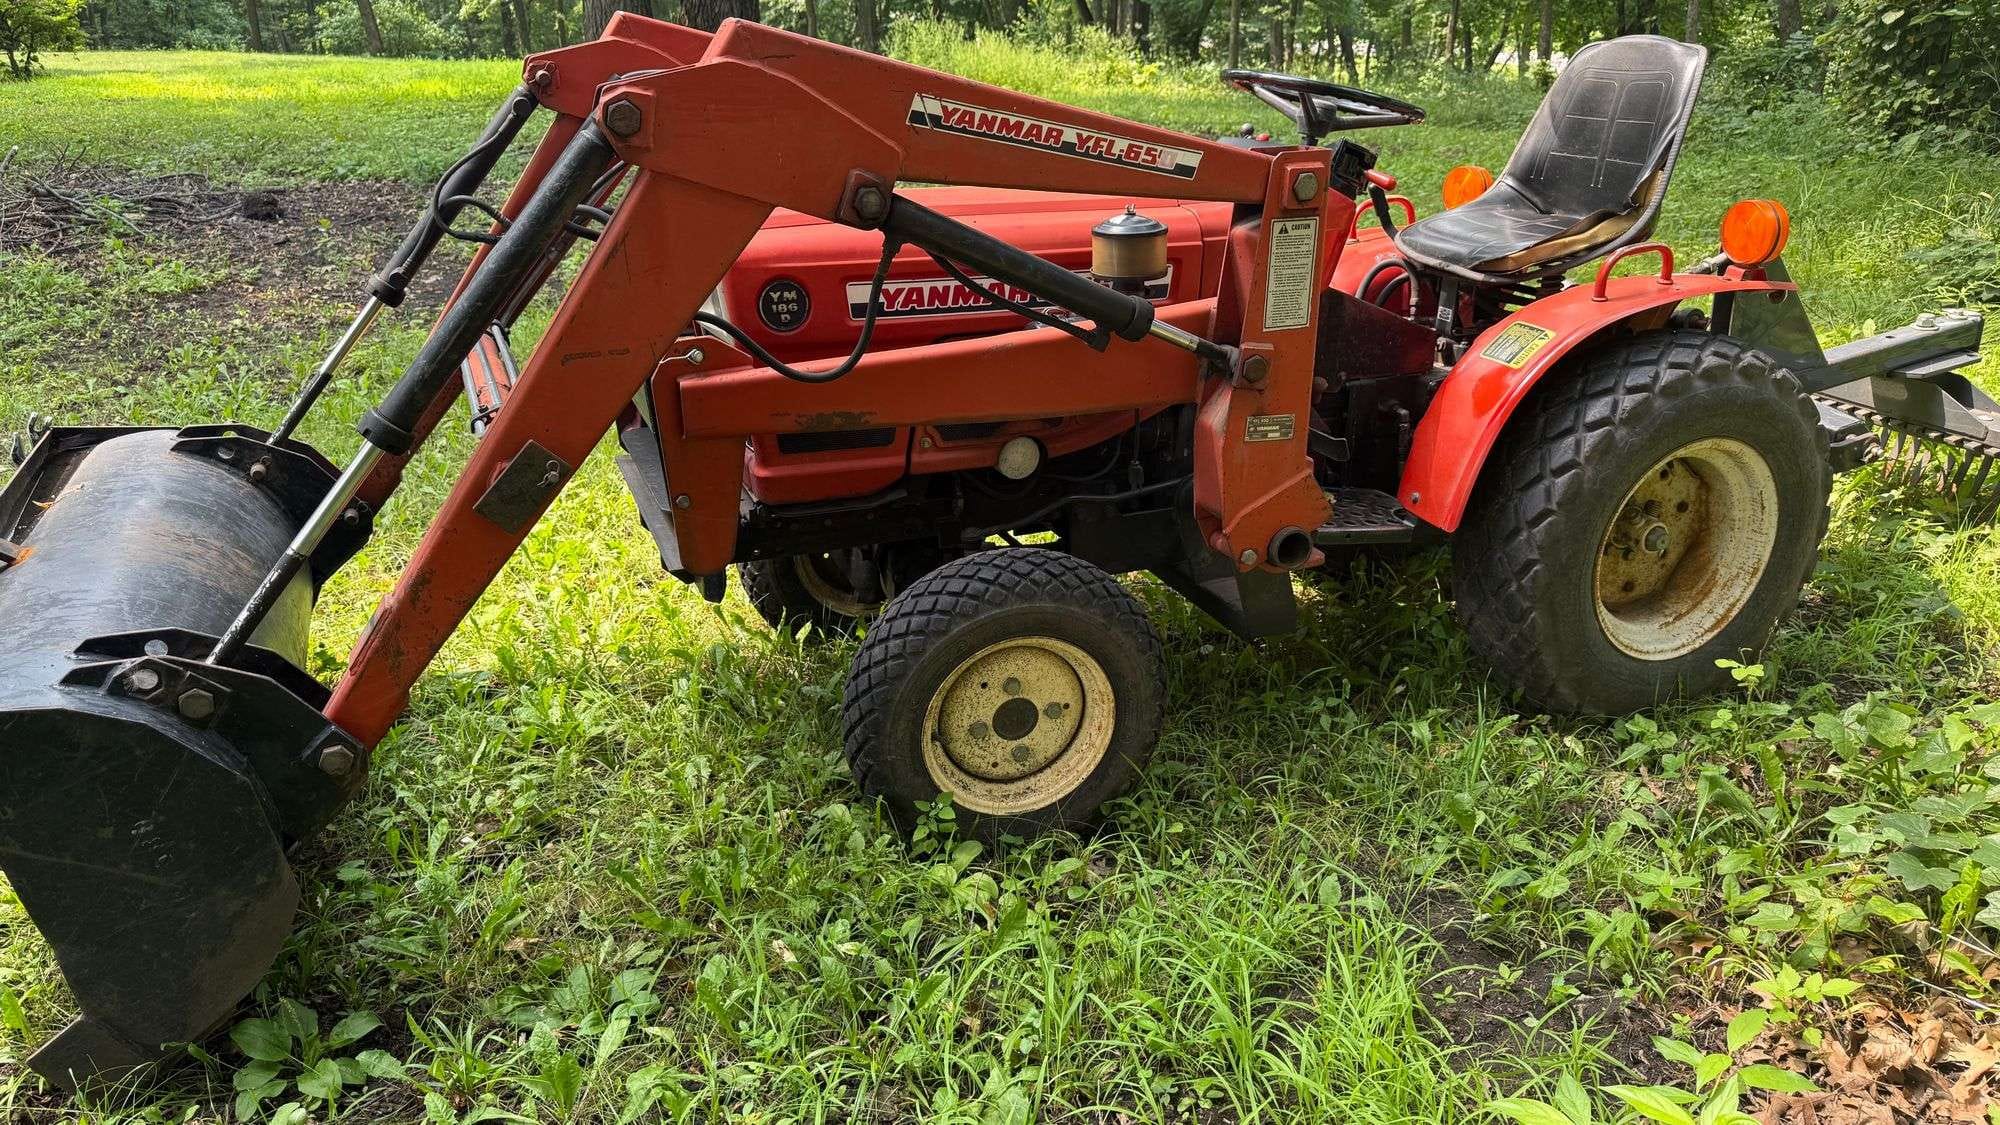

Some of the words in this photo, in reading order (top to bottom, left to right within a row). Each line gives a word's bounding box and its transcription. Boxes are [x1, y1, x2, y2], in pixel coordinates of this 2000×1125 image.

[940, 103, 1064, 147] YANMAR
[1291, 223, 1311, 231] CAUTION
[771, 303, 798, 313] 186
[780, 313, 791, 323] D
